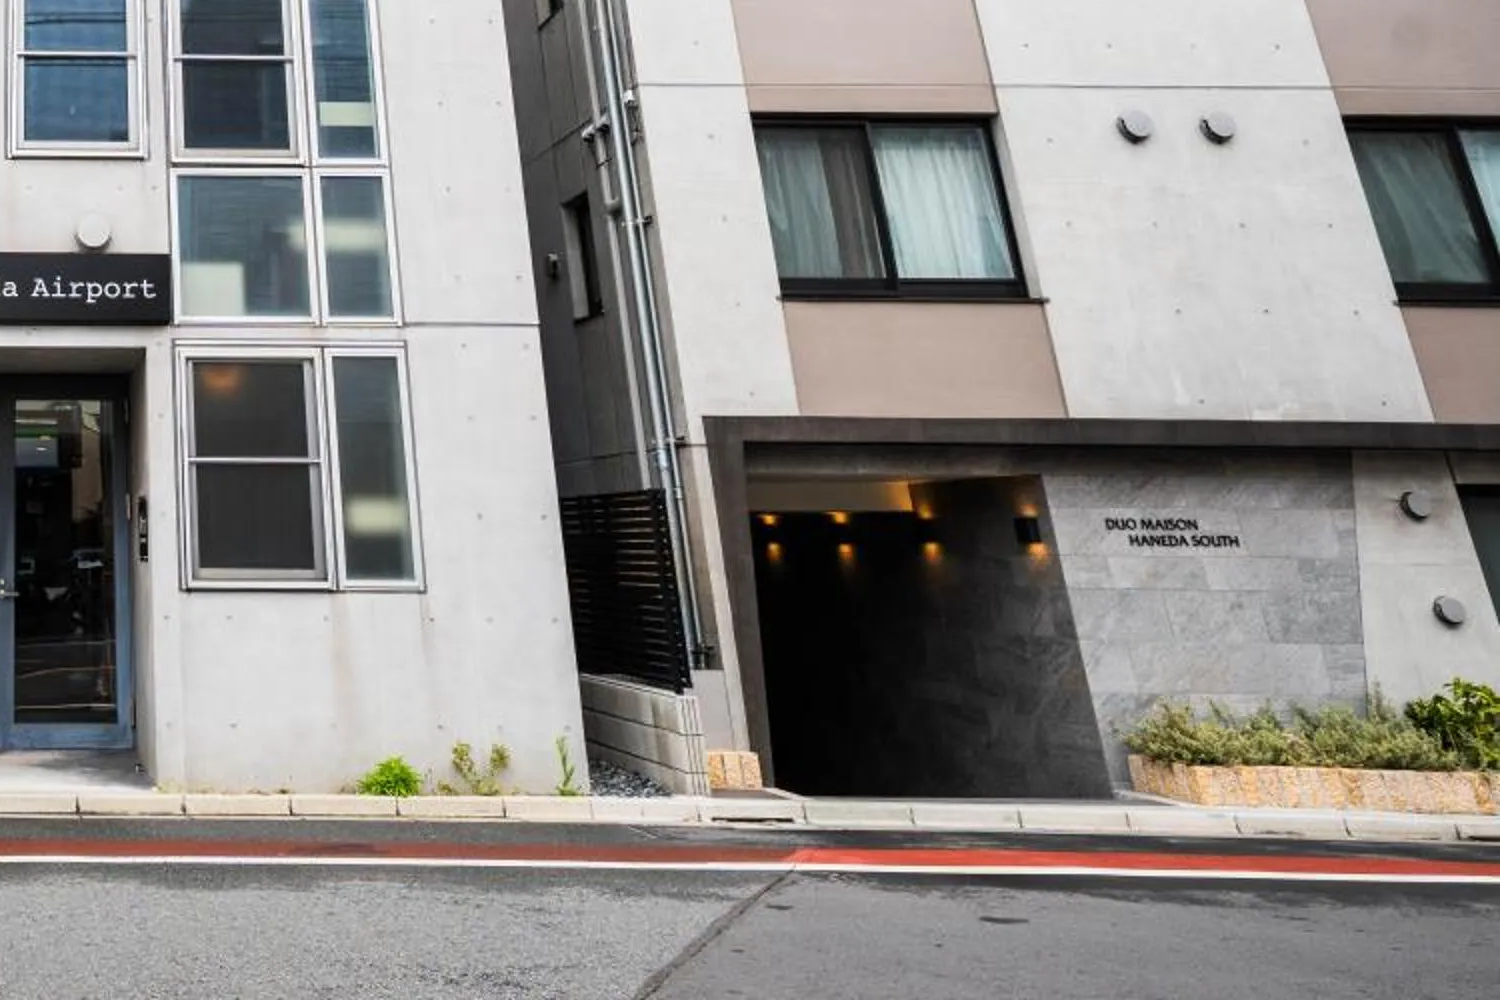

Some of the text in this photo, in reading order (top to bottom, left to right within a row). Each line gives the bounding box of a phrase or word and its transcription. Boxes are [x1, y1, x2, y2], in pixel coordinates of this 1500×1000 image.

[31, 277, 157, 302] Airport
[1105, 517, 1199, 531] DUO MAISON
[1128, 534, 1240, 548] HANEDA SOUTH
